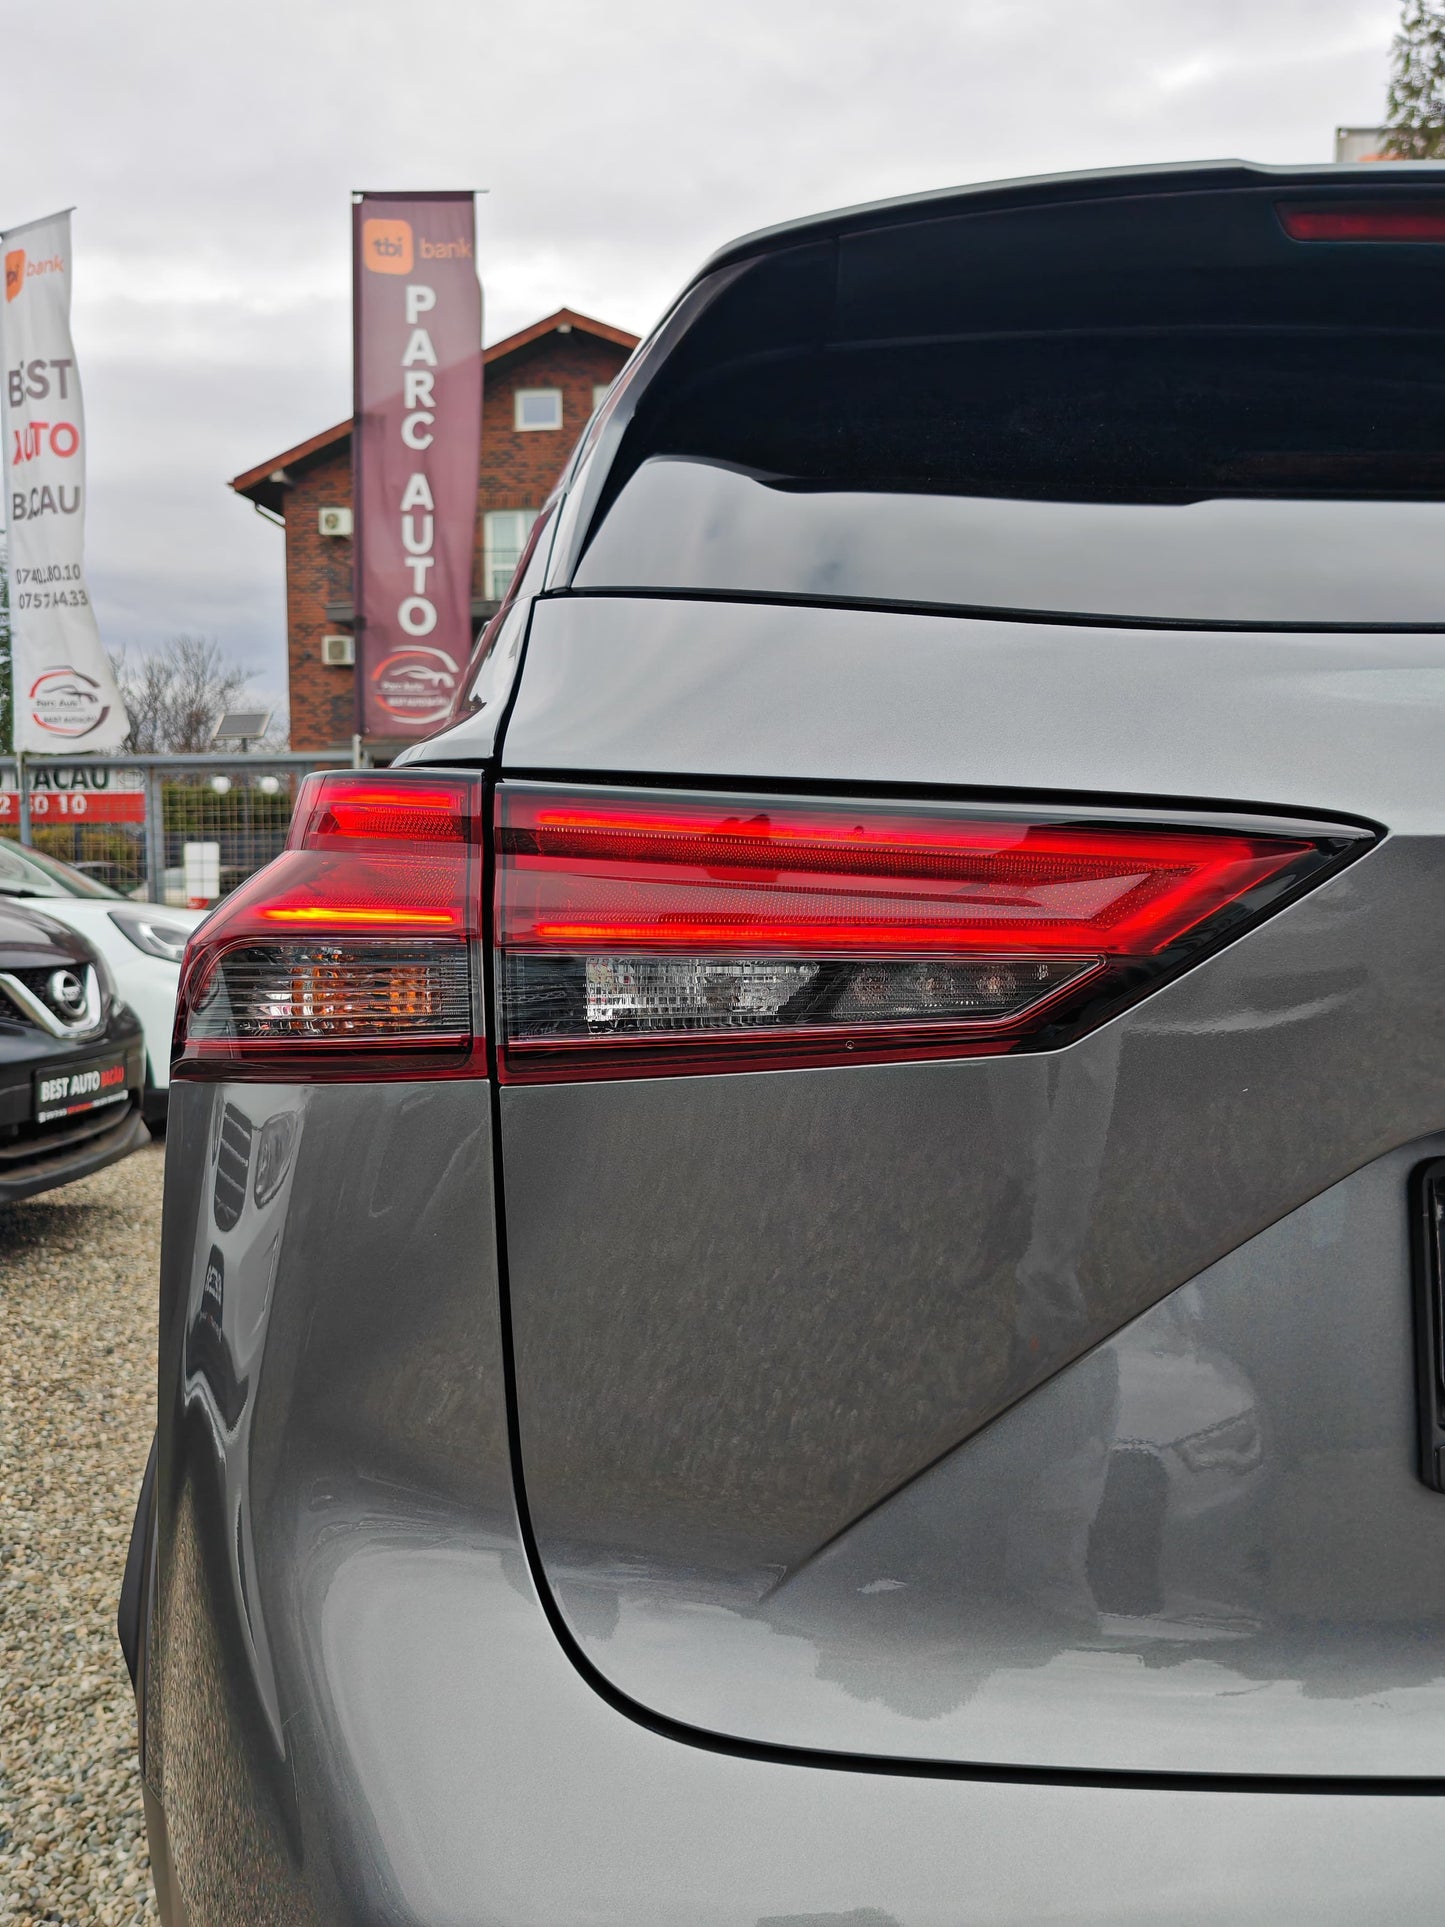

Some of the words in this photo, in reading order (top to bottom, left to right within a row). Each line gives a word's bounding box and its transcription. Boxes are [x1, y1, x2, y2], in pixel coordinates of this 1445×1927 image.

[419, 236, 474, 259] bank
[26, 254, 65, 278] bank
[401, 284, 438, 450] PARC
[8, 358, 73, 408] BST
[397, 473, 438, 637] AUTO
[15, 766, 110, 790] ACAU
[58, 794, 88, 815] 10
[41, 1077, 70, 1103] BEST
[69, 1070, 101, 1097] AUTO
